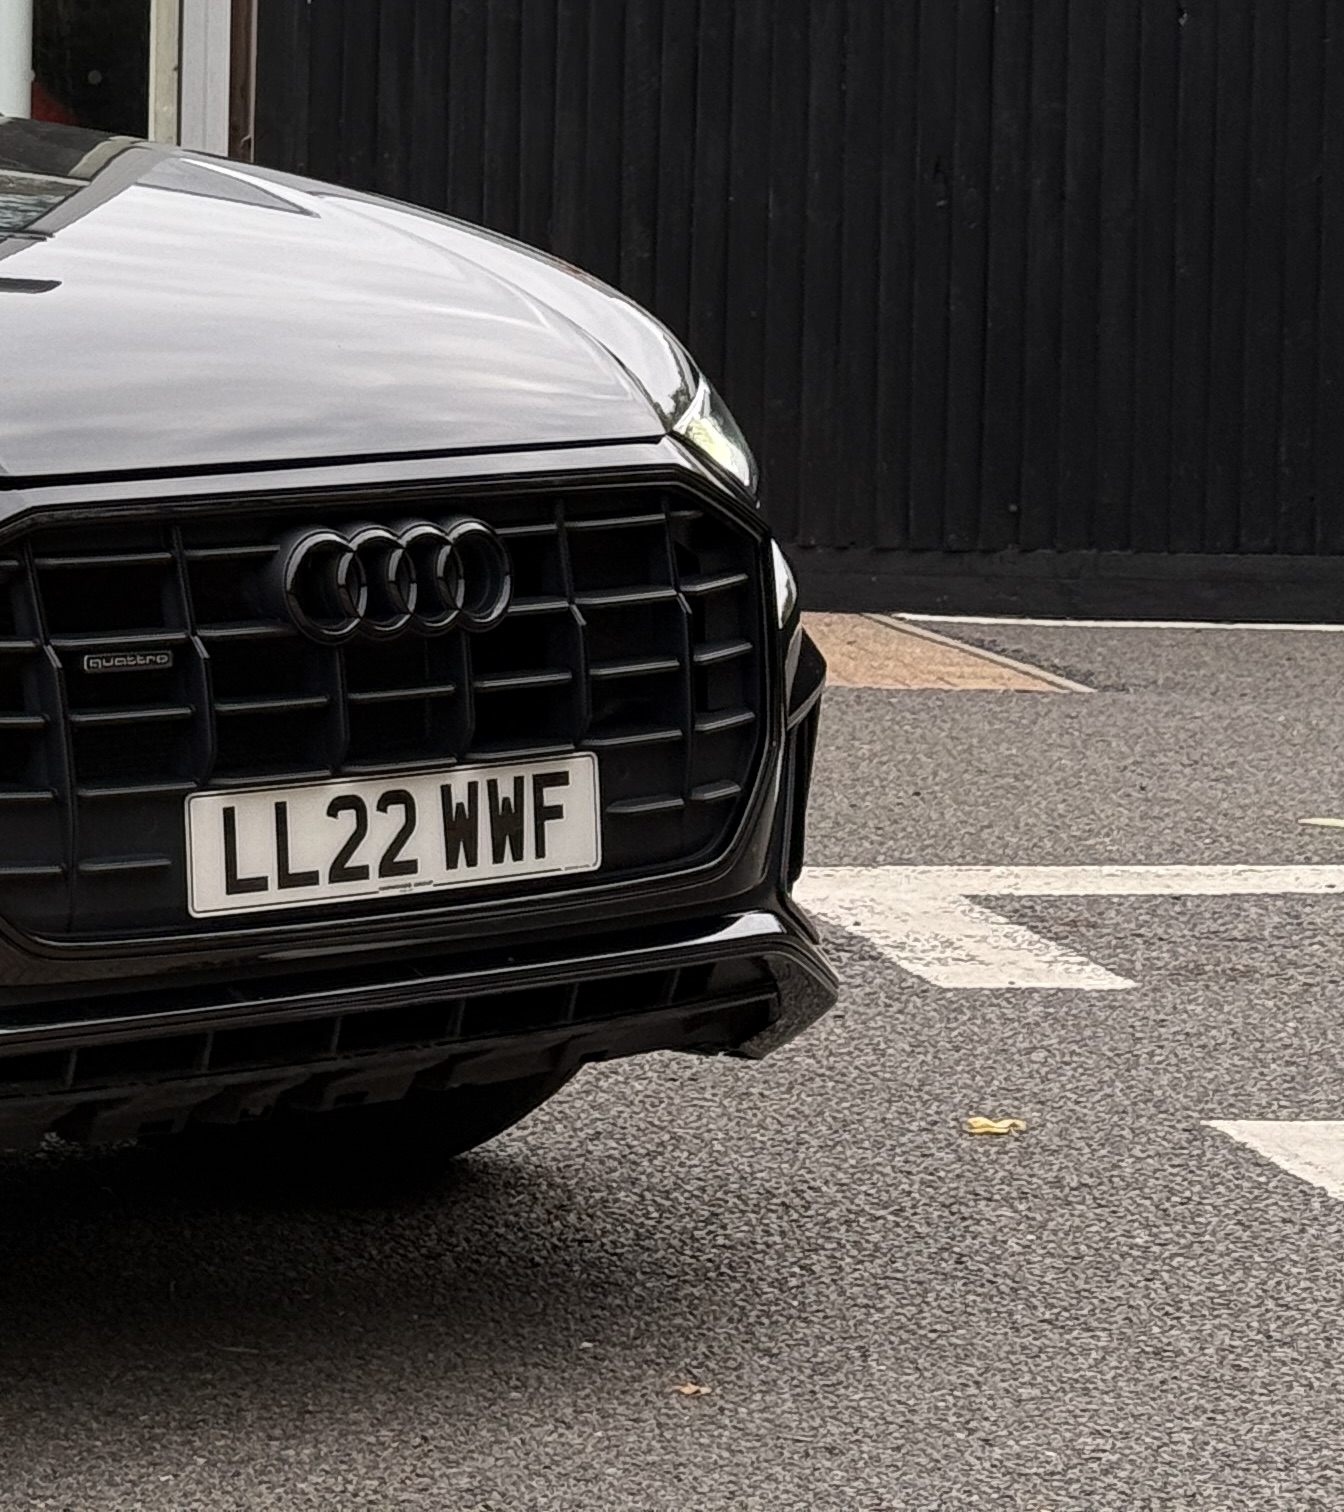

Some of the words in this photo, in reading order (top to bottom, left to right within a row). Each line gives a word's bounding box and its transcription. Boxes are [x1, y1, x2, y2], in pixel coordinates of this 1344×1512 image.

[88, 653, 170, 669] quattro
[221, 789, 419, 896] LL22
[439, 770, 570, 871] WWF
